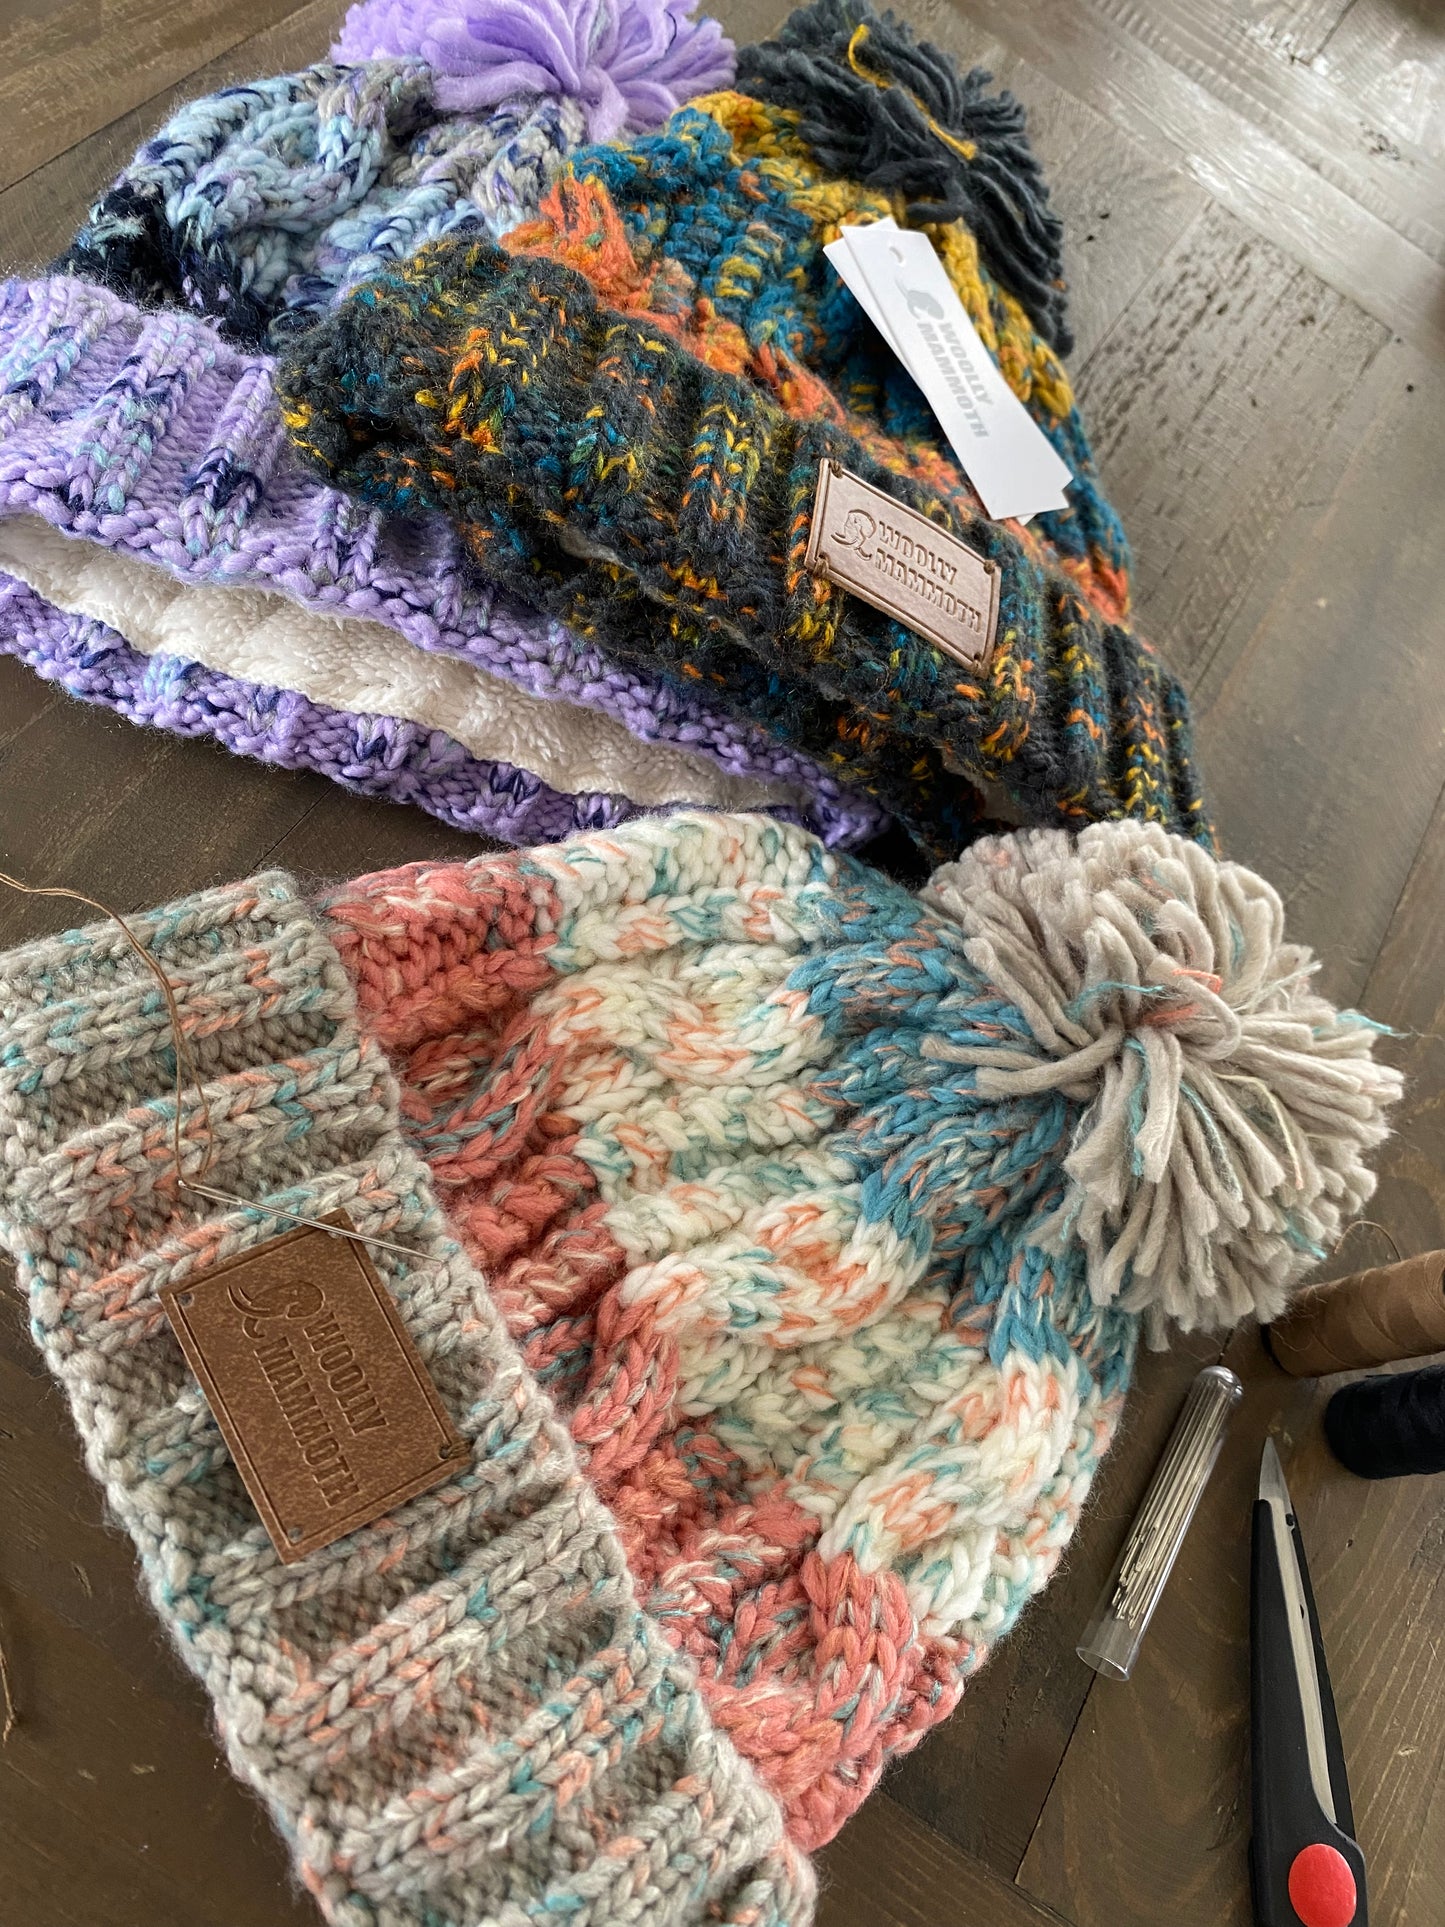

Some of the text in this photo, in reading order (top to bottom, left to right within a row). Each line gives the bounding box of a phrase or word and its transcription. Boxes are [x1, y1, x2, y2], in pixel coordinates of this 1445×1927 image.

[917, 322, 990, 438] MAMMOTH
[940, 322, 993, 405] WOOLLY
[874, 548, 982, 633] MAMMOTH
[879, 521, 957, 585] WOOLLY
[254, 1336, 360, 1507] MAMMOTH
[303, 1311, 390, 1436] WOOLLY
